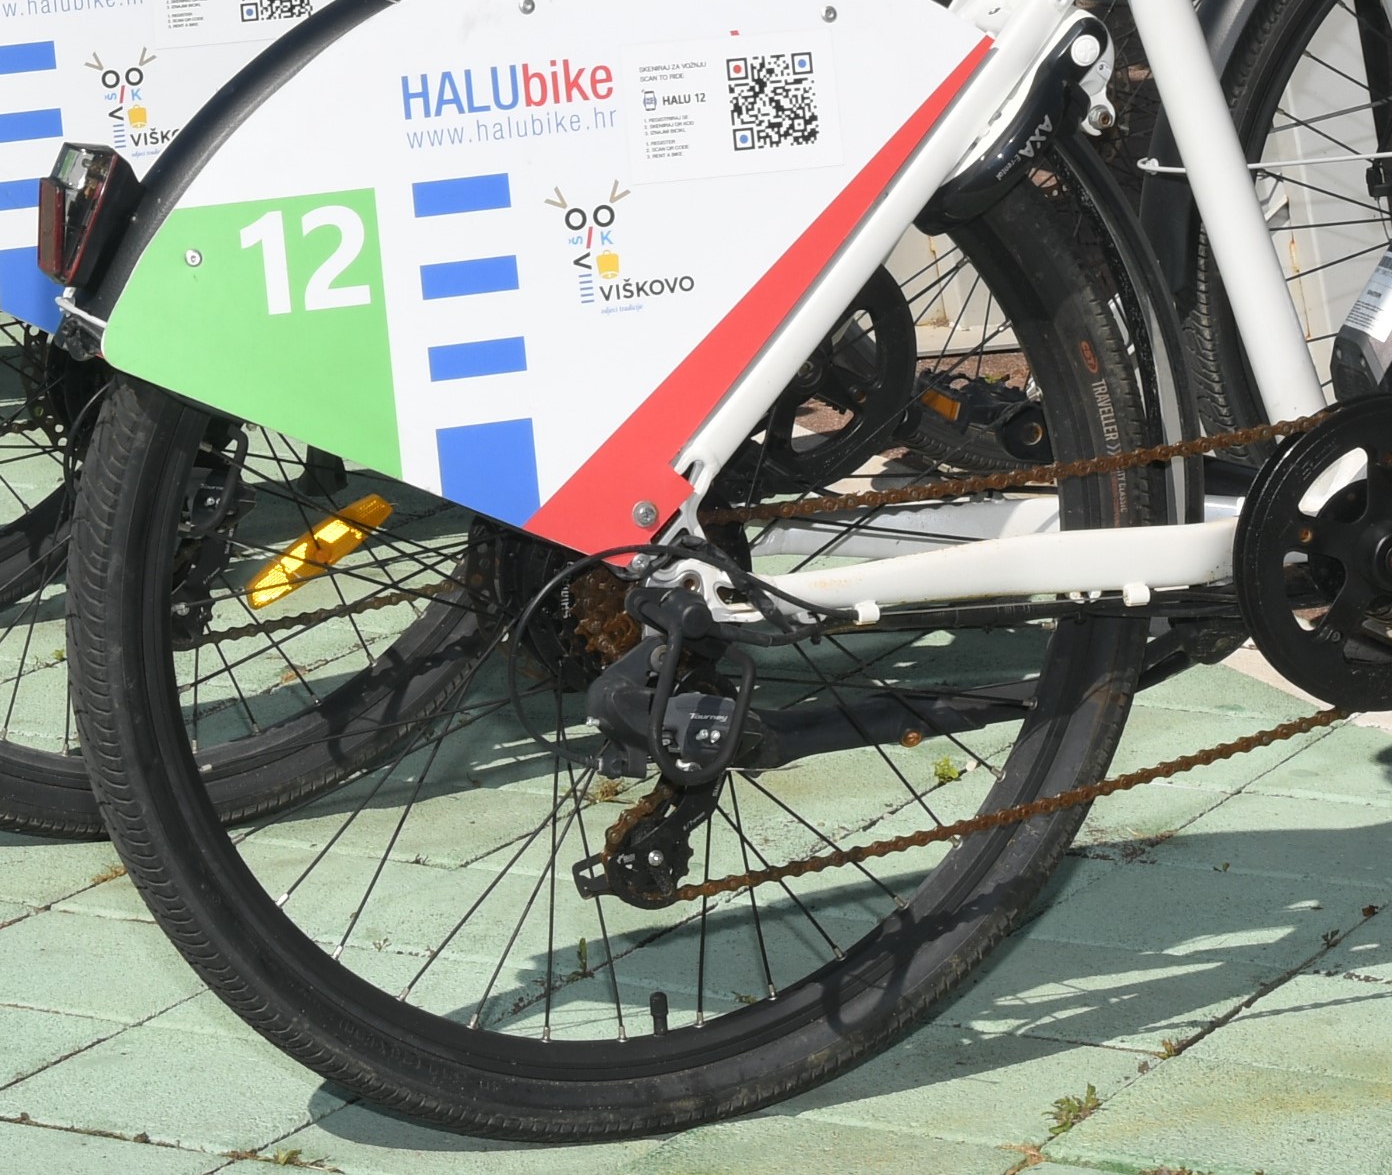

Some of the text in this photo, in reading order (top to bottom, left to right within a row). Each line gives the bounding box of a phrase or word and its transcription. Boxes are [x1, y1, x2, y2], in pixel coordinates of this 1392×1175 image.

[401, 59, 614, 120] HALUbike
[662, 93, 706, 106] HALU 12
[406, 108, 617, 150] www.halubike.hr
[1018, 114, 1053, 158] AXA
[239, 205, 372, 316] 12
[599, 275, 695, 302] VIŠKOVO
[689, 712, 729, 723] Tourney
